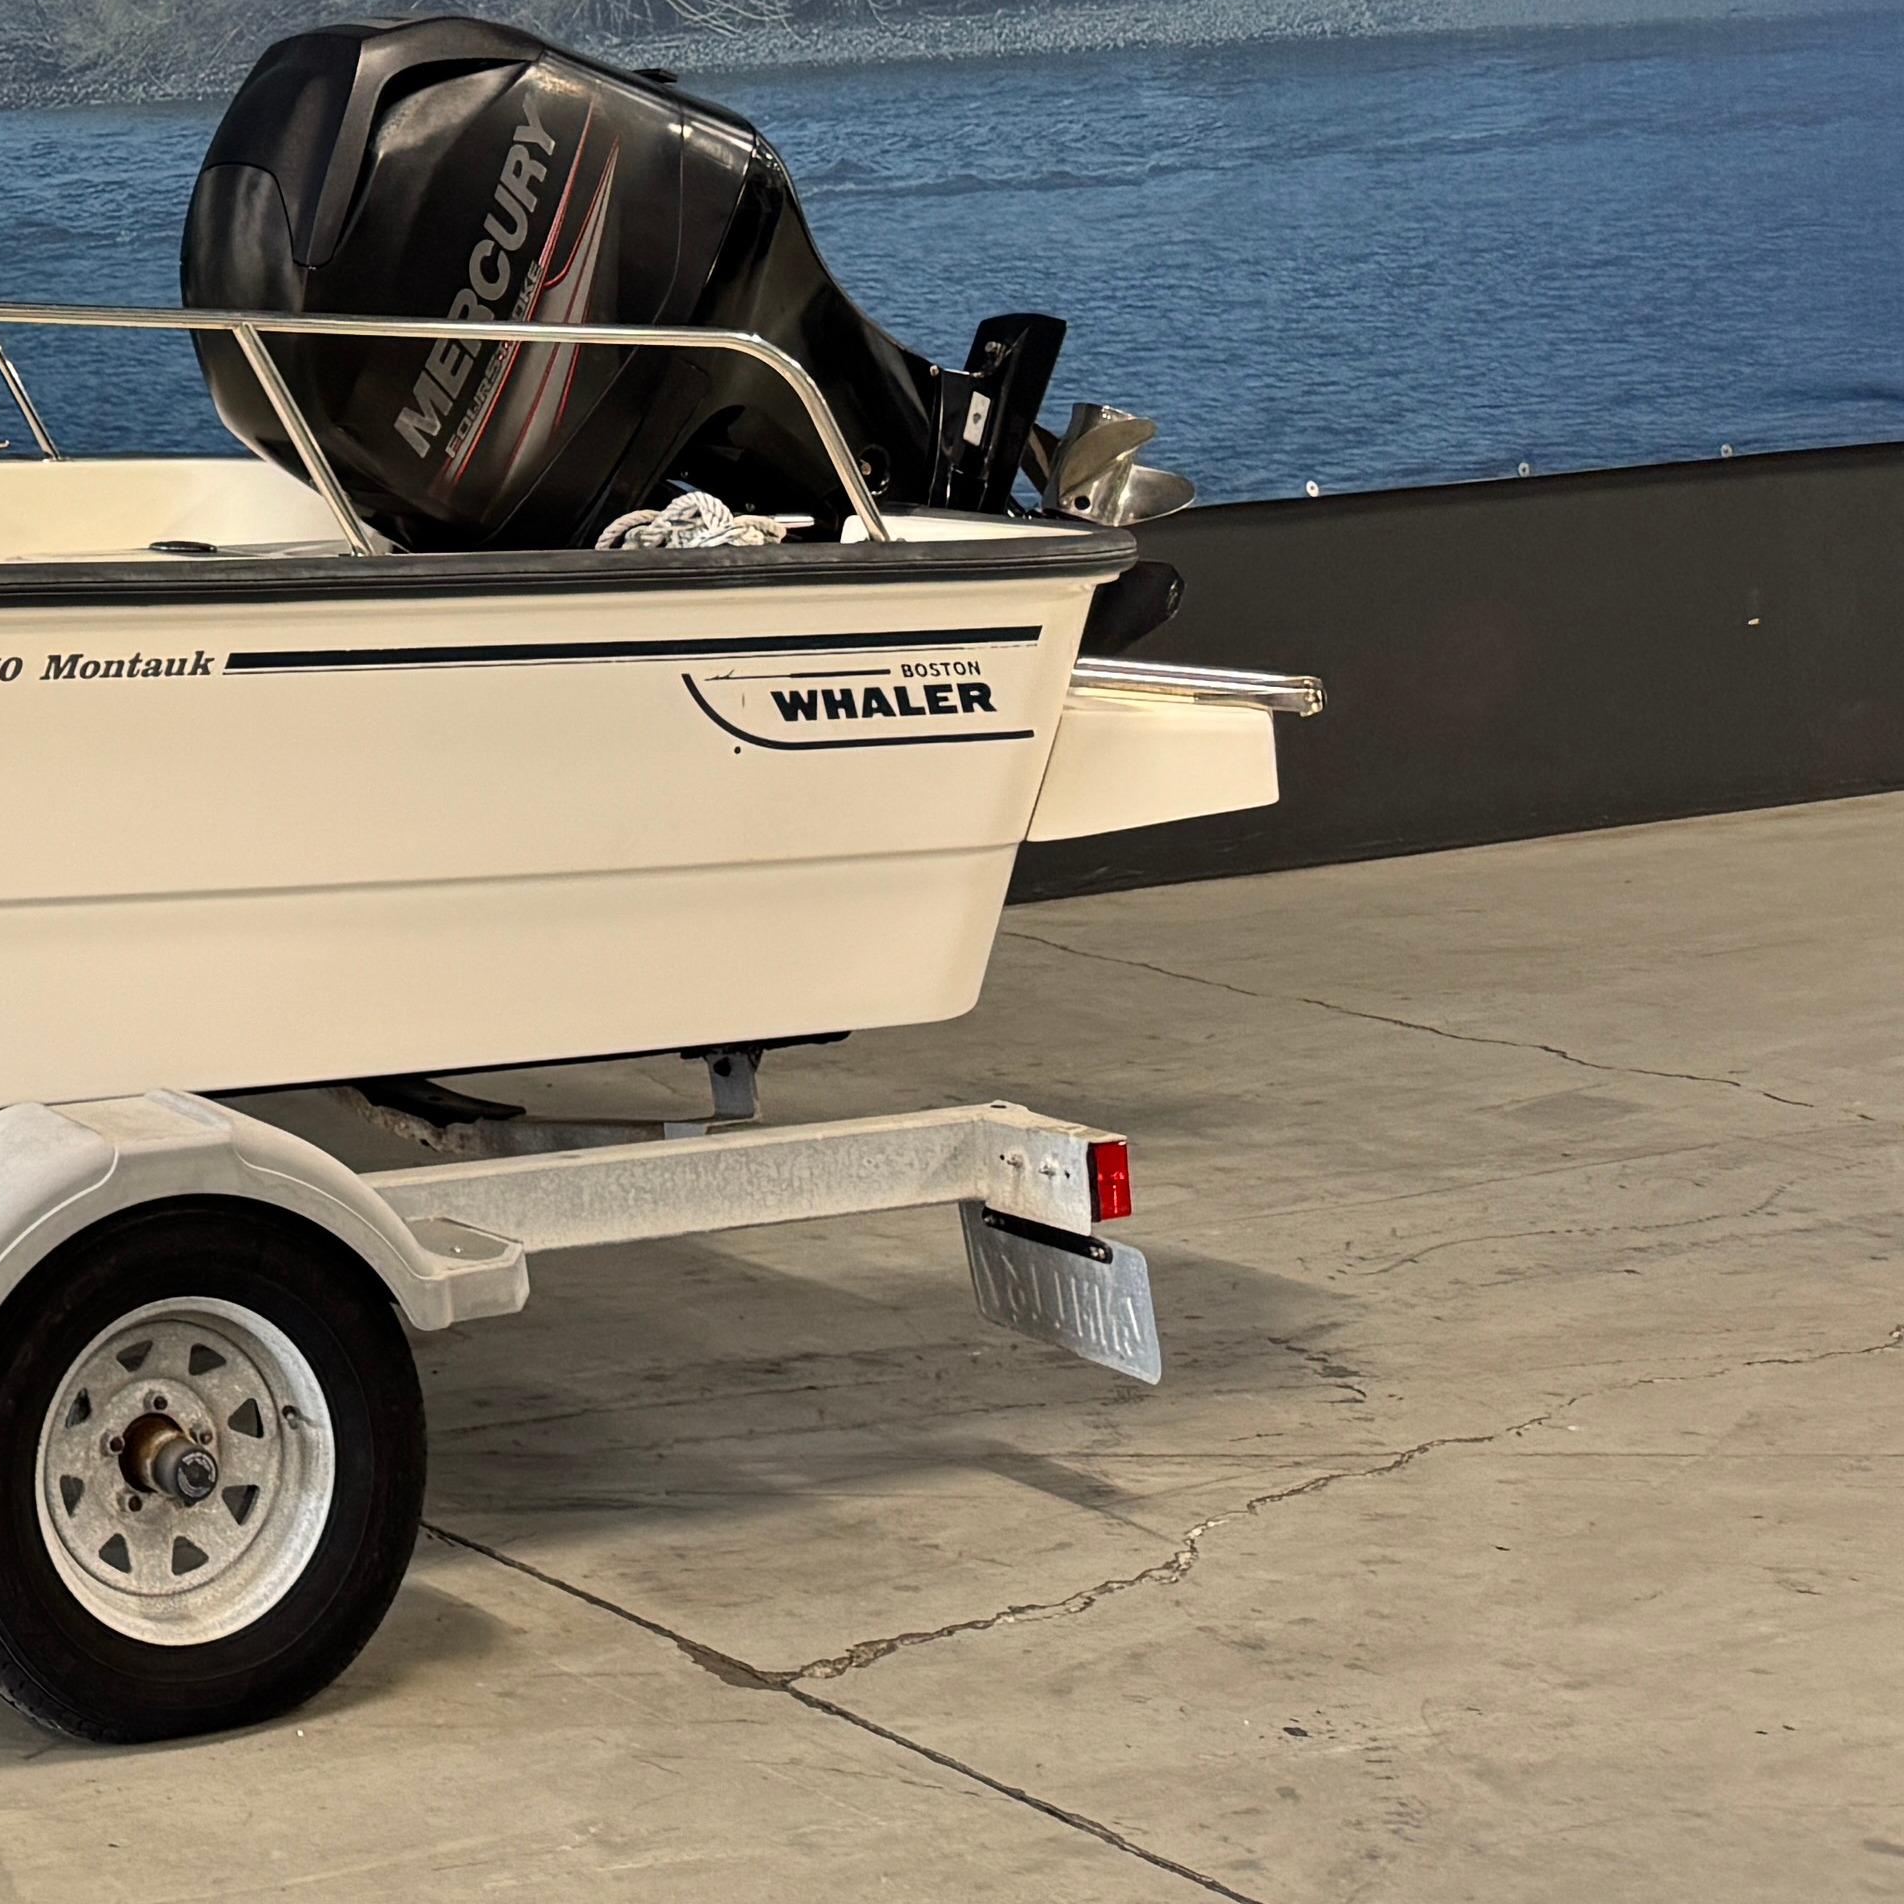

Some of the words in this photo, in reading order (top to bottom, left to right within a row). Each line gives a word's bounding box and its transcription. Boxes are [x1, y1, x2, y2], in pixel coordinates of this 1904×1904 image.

[394, 93, 556, 459] MERCURY
[39, 649, 216, 681] Montauk
[900, 660, 982, 679] BOSTON
[769, 682, 998, 722] WHALER
